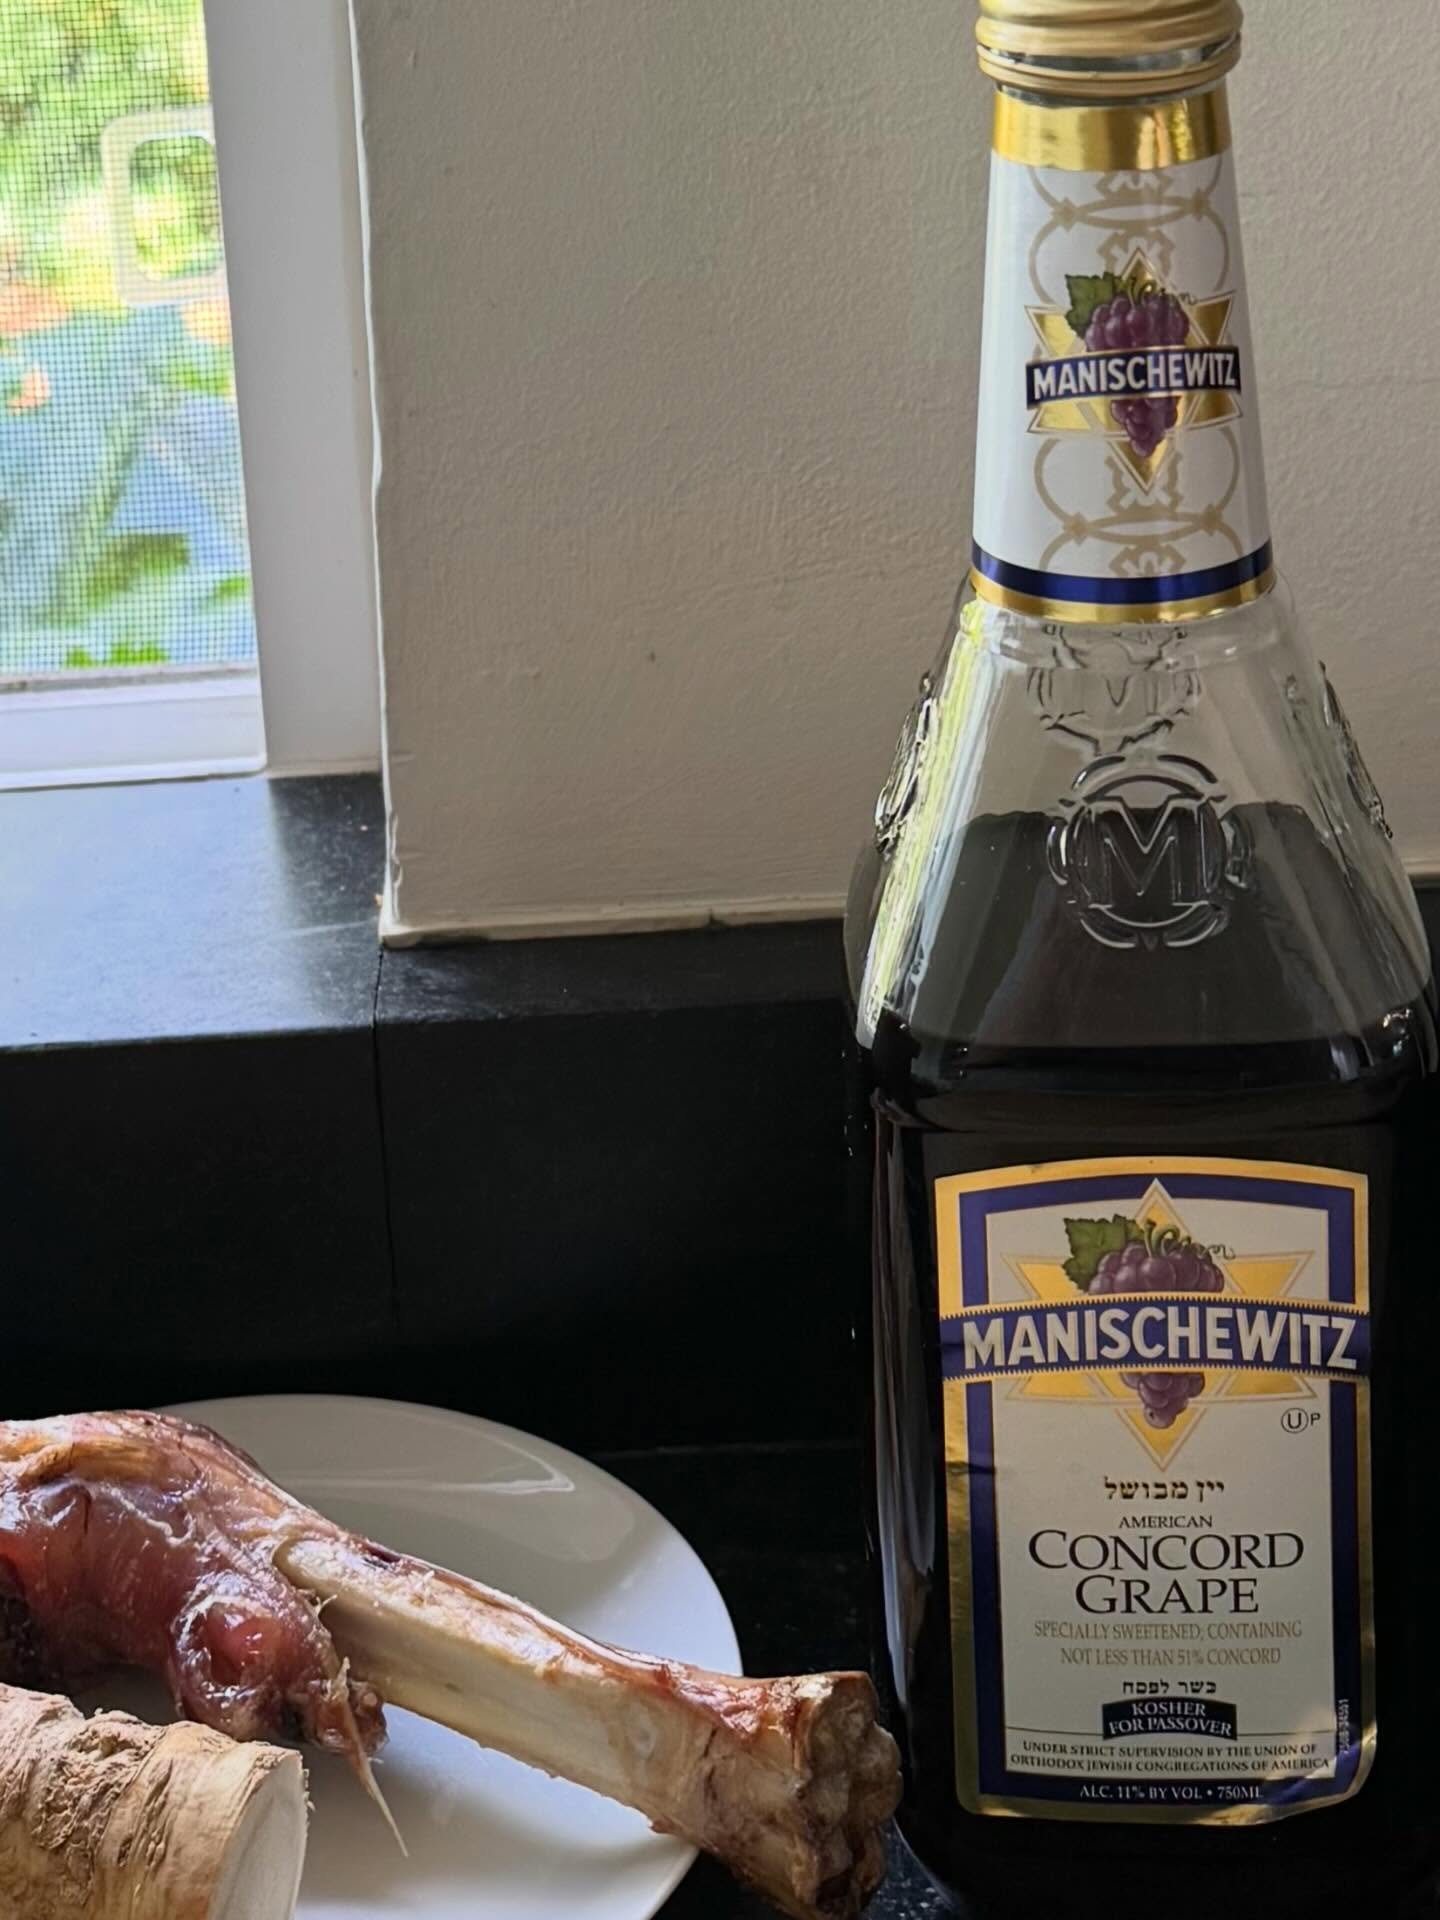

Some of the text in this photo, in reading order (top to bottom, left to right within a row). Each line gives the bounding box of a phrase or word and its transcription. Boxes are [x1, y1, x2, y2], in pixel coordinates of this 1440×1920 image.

[1033, 352, 1237, 400] MANISCHEWITZ
[962, 1306, 1358, 1371] MANISCHEWITZ
[1104, 1476, 1225, 1502] יין מבושל
[1118, 1515, 1213, 1528] AMERICAN
[1028, 1529, 1305, 1571] CONCORD
[1075, 1574, 1259, 1614] GRAPE
[1034, 1620, 1108, 1640] SPECIALLY
[1207, 1620, 1303, 1640] CONTAINING
[1060, 1647, 1281, 1666] NOT LESS THAN 51% CONCORD
[1122, 1678, 1217, 1694] כשר לפסח
[1132, 1702, 1206, 1717] KOSHER
[1109, 1716, 1232, 1737] FOR PASSOVER
[1023, 1740, 1317, 1758] UNDER STRICT SUPERVISION BY THE UNION OF
[1010, 1753, 1330, 1772] ORTHODOX JEWISH CONGREGATIONS OF AMERICA
[1079, 1784, 1265, 1800] ALC. 11% BY VOL 750ML
